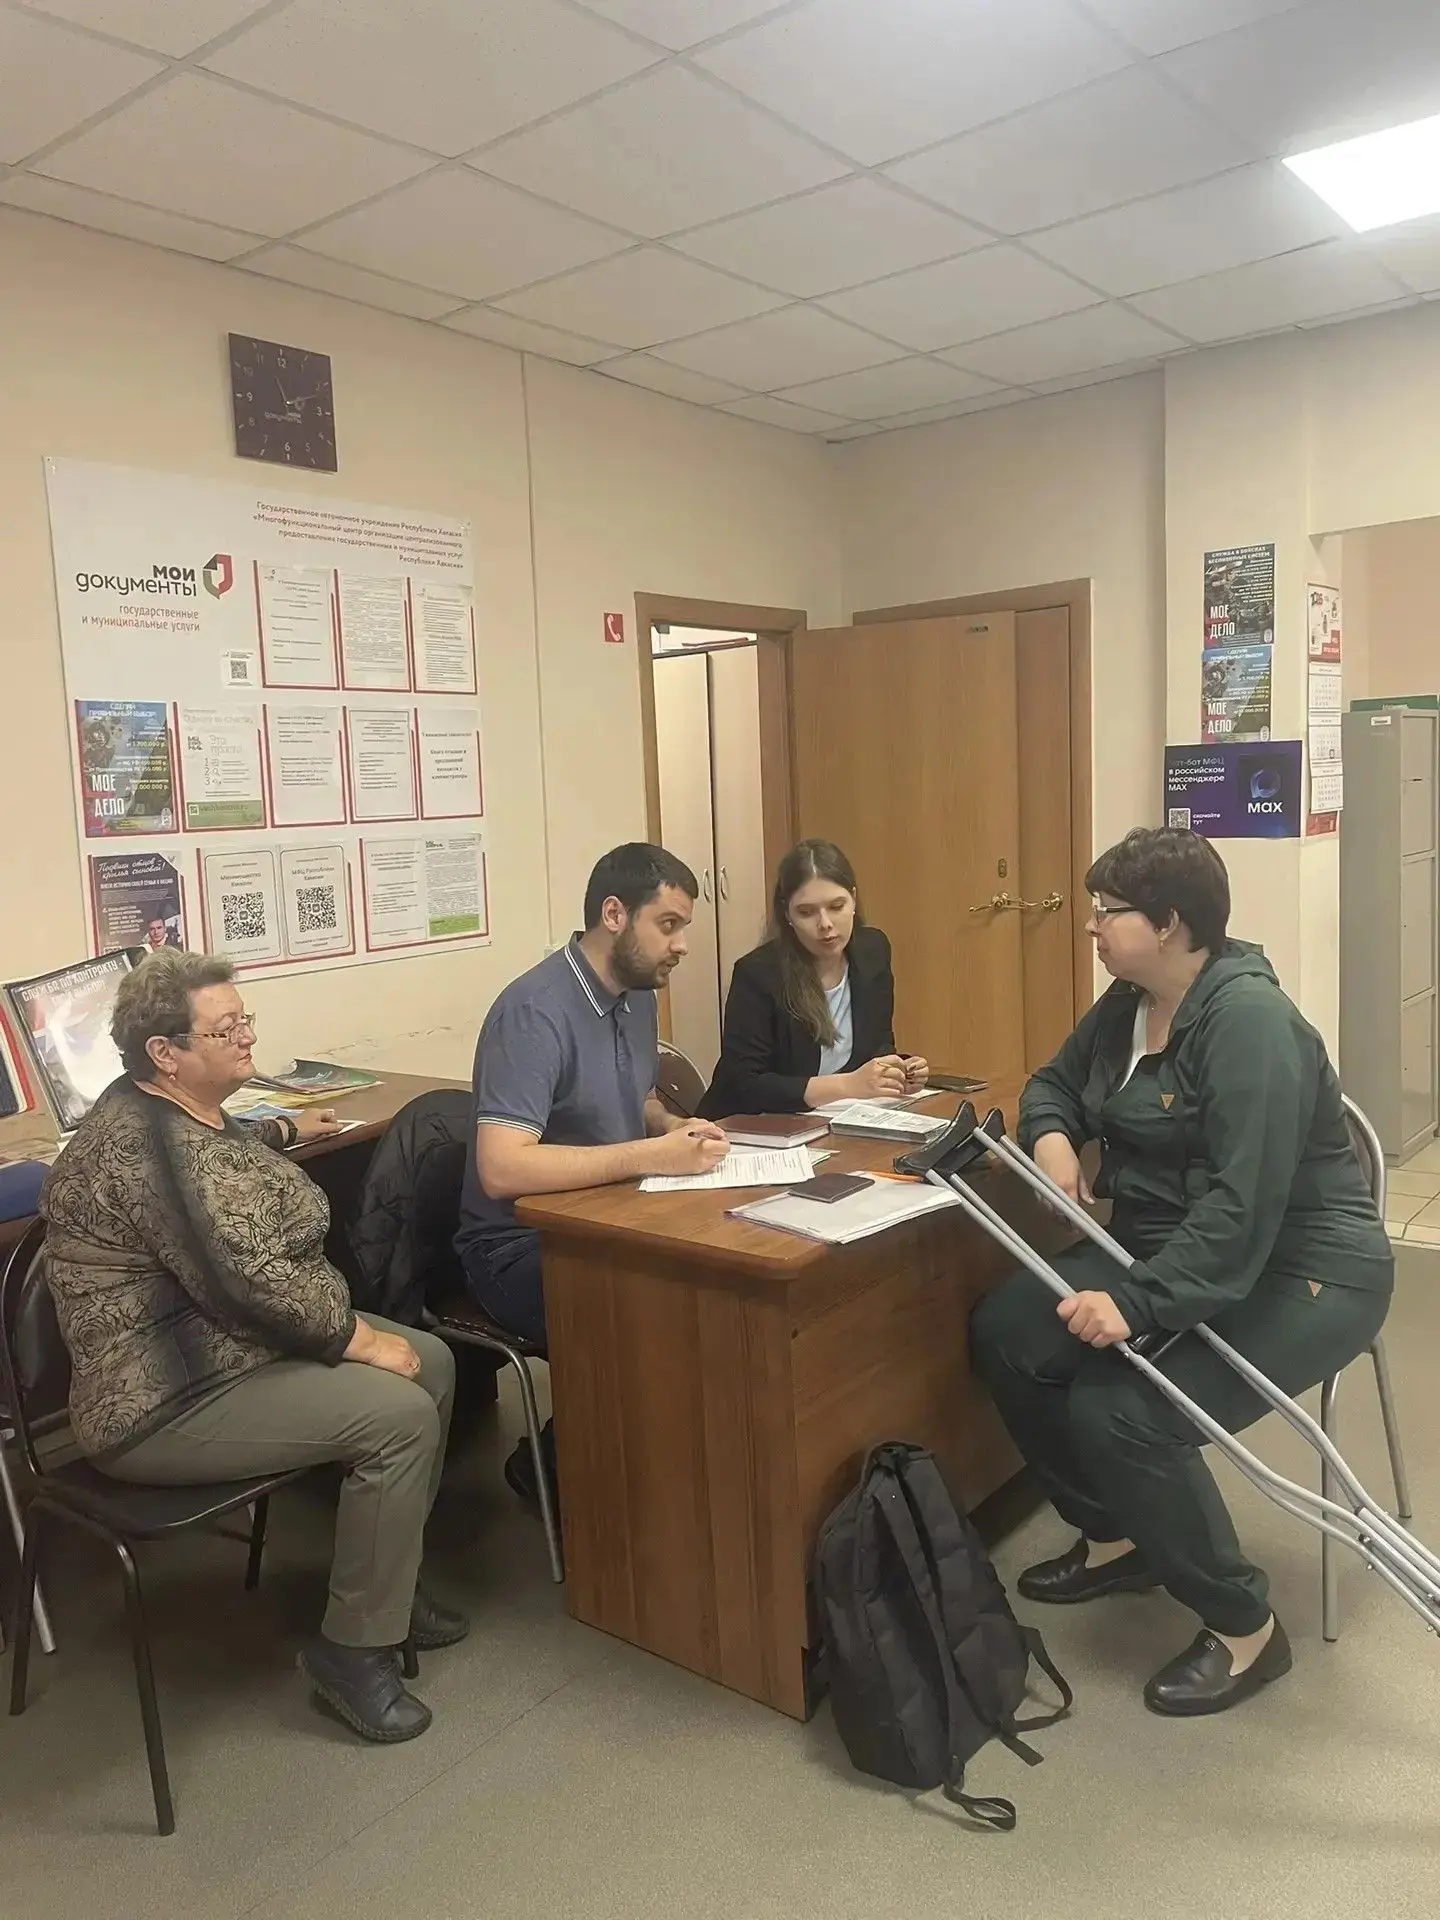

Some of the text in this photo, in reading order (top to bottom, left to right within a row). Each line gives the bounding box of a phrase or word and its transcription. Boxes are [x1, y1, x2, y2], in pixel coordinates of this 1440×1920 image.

[277, 357, 286, 369] 12
[246, 391, 253, 402] 9
[316, 406, 322, 417] 3
[284, 441, 291, 452] 6
[256, 501, 319, 518] Государственное
[152, 564, 196, 582] мои
[76, 572, 197, 597] документы
[119, 604, 199, 619] государственные
[81, 615, 200, 633] и муниципальные услуги
[1210, 622, 1235, 640] ДЕЛО
[1207, 719, 1232, 734] ДЕЛО
[1174, 766, 1225, 776] российском
[1168, 775, 1225, 784] мессенджере
[94, 798, 125, 818] ДЕЛО
[72, 960, 119, 984] КОНТРАКТУ
